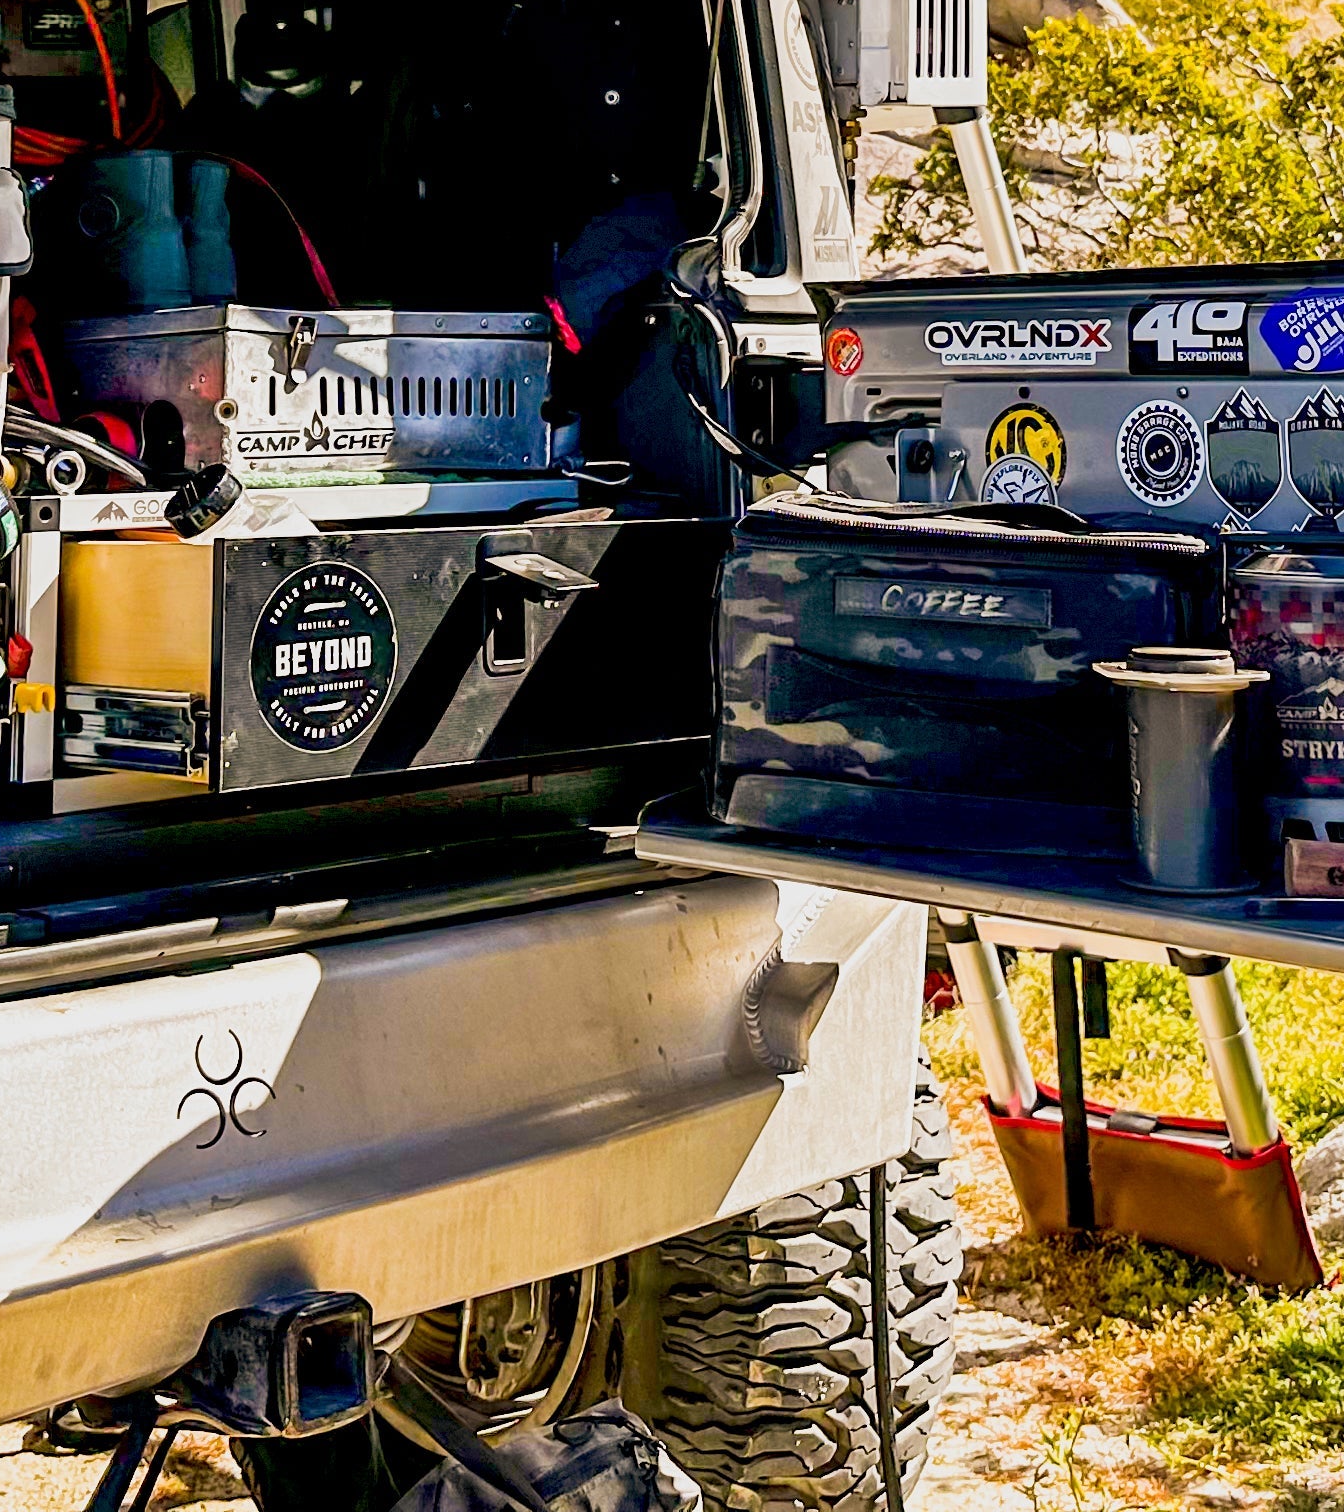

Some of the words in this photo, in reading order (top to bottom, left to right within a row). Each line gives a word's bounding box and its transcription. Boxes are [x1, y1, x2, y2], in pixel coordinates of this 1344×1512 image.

[927, 323, 1108, 349] OVRLNDX
[1216, 337, 1244, 347] BAJA
[944, 352, 1007, 361] OVERLAND
[1018, 352, 1092, 361] ADVENTURE
[1177, 351, 1244, 362] EXPEDITIONS
[237, 435, 300, 454] CAMP
[333, 432, 396, 451] CHEF
[880, 583, 1008, 619] COFFEE
[275, 635, 372, 677] BEYOND
[1276, 709, 1318, 720] CAMP
